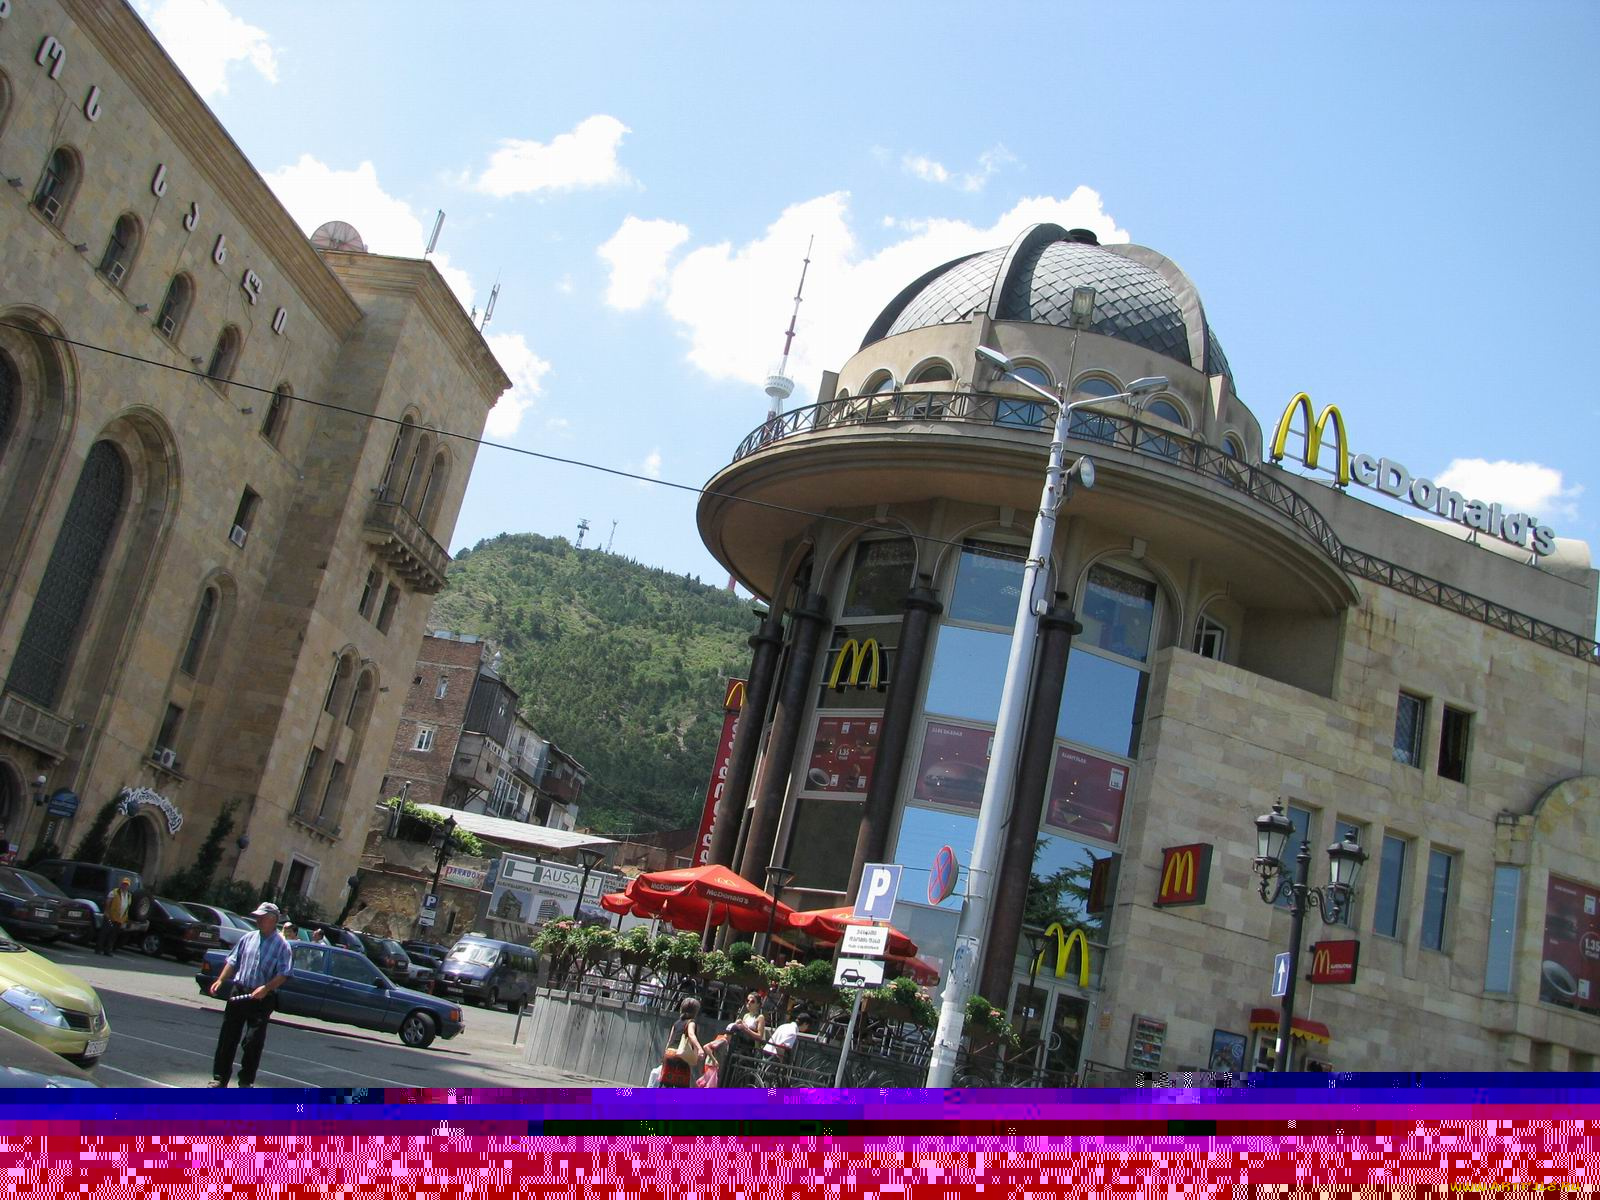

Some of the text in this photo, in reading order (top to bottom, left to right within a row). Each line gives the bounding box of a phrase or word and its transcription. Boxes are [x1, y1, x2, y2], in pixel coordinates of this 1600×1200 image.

[1270, 391, 1556, 556] McDonald's
[503, 860, 600, 890] HAUSAT
[864, 868, 892, 911] P
[1161, 851, 1194, 897] M
[425, 895, 437, 907] P
